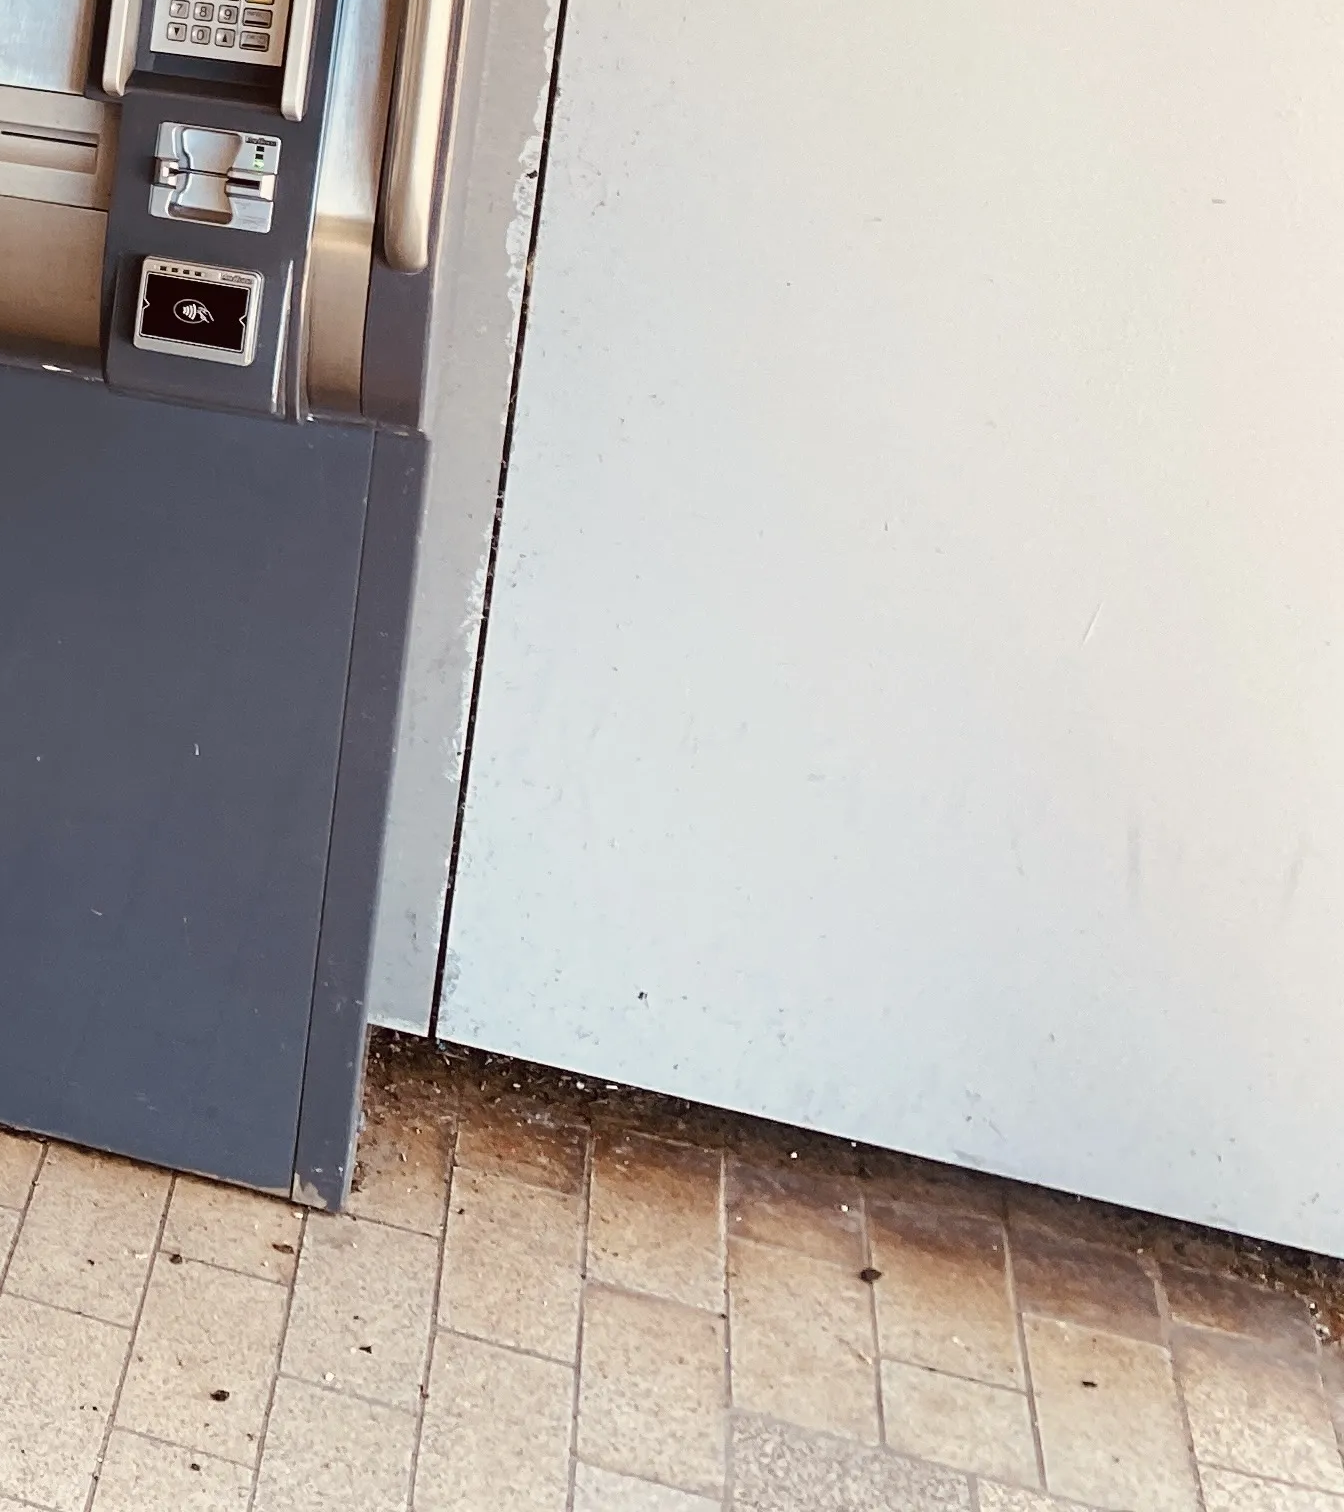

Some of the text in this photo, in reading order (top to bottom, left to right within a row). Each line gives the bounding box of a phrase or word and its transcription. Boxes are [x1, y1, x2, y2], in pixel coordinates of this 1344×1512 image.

[175, 3, 184, 15] 7
[199, 6, 208, 18] 8
[223, 8, 232, 21] 9
[196, 29, 205, 41] 0
